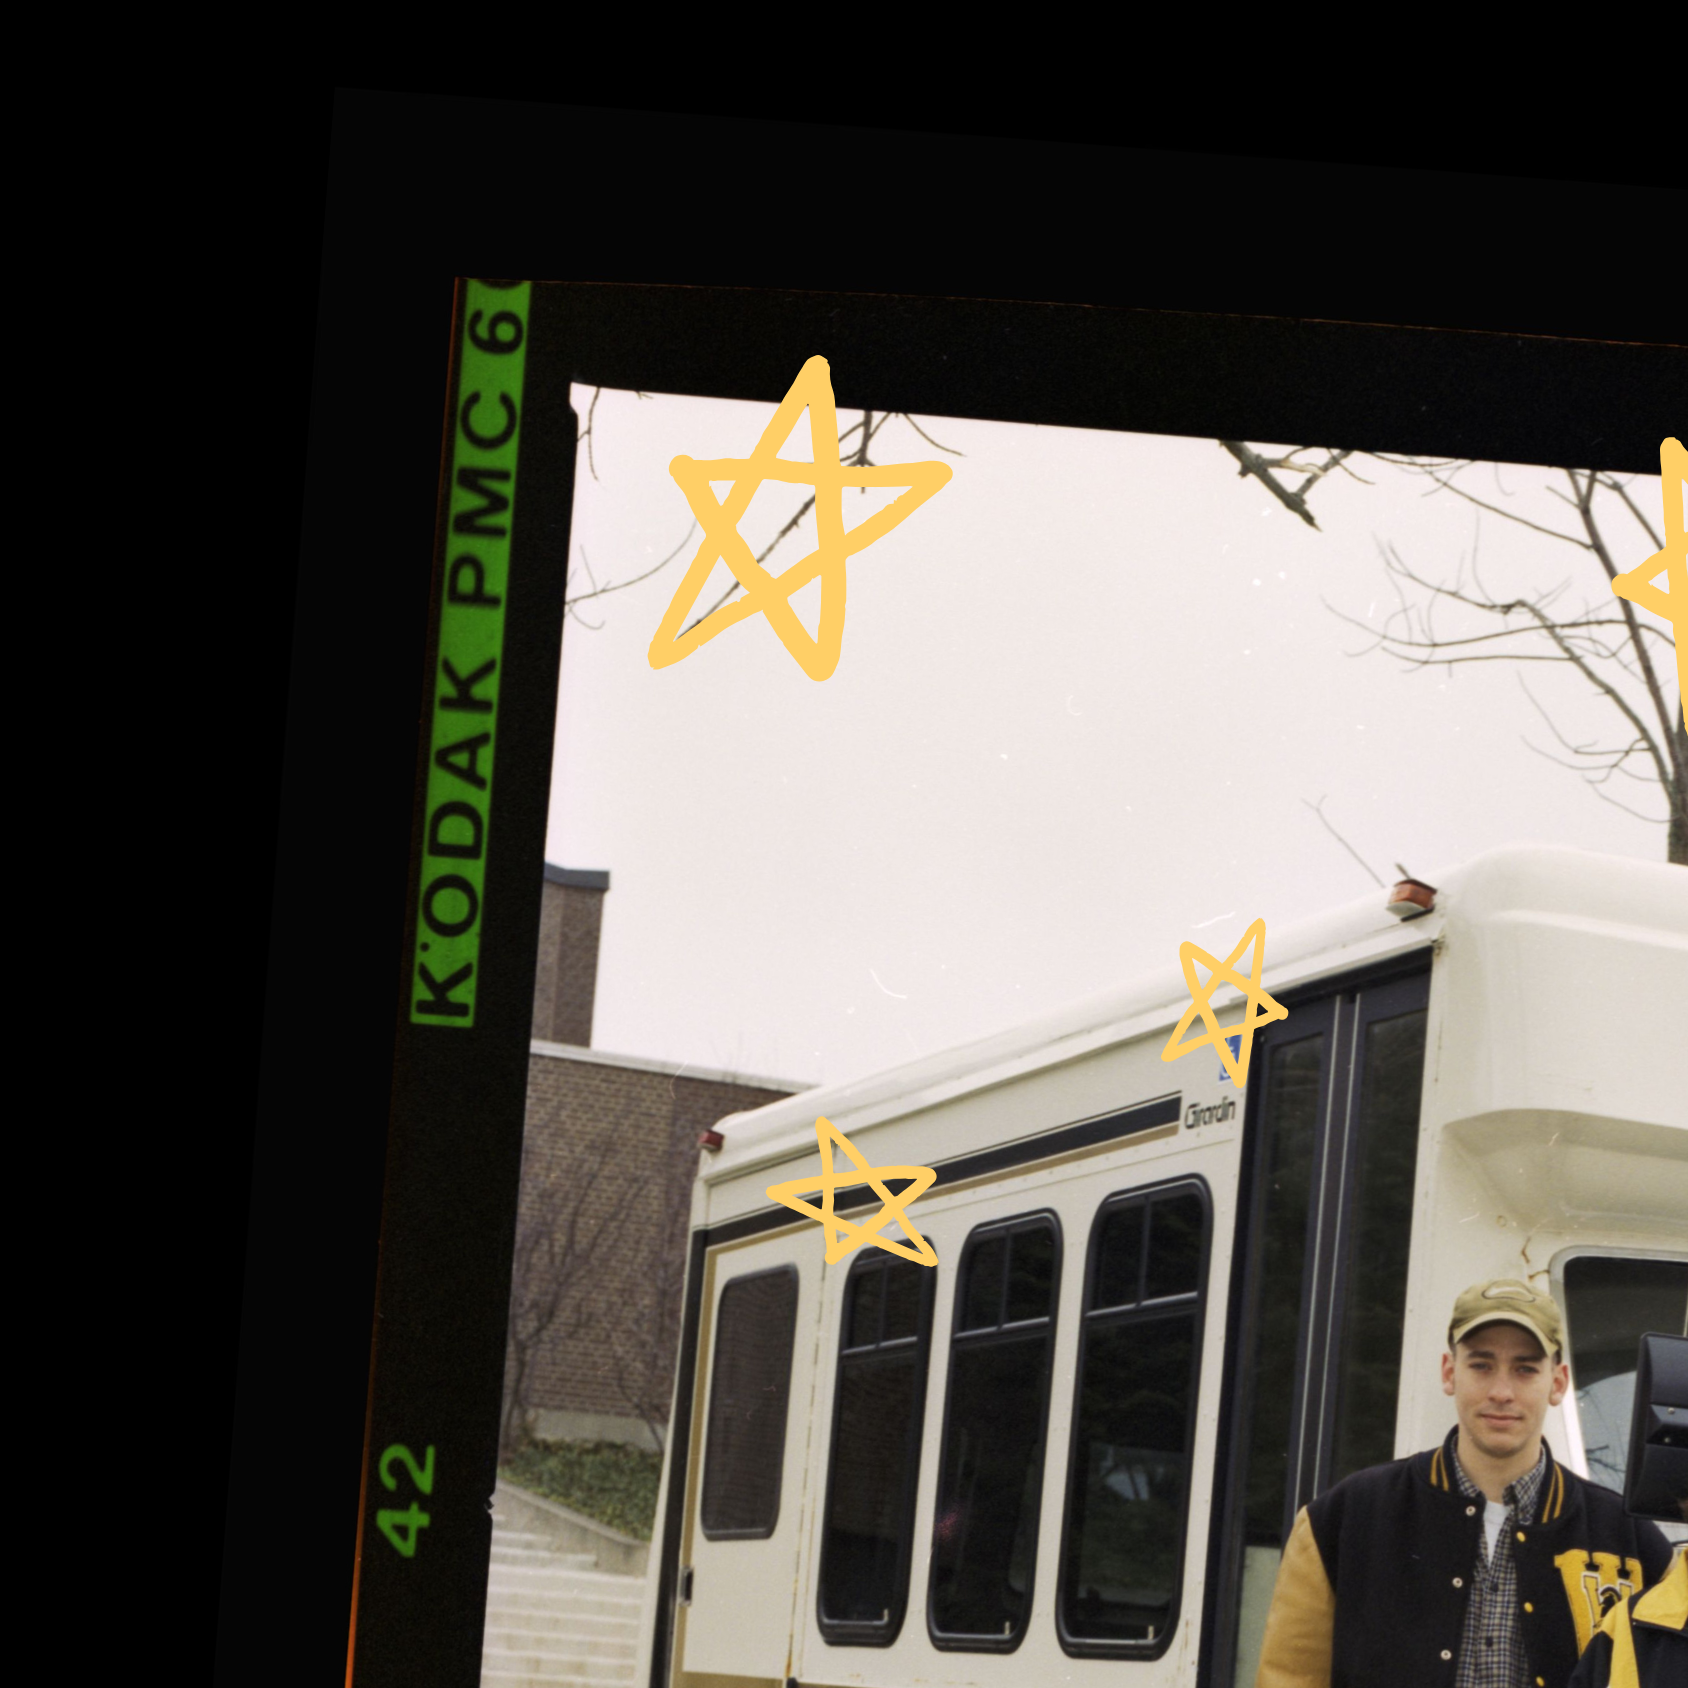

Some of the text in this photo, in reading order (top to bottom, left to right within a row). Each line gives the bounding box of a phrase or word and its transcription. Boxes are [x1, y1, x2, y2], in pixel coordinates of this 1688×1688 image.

[415, 280, 525, 1019] KODAK PMC 6
[376, 1443, 435, 1558] 42
